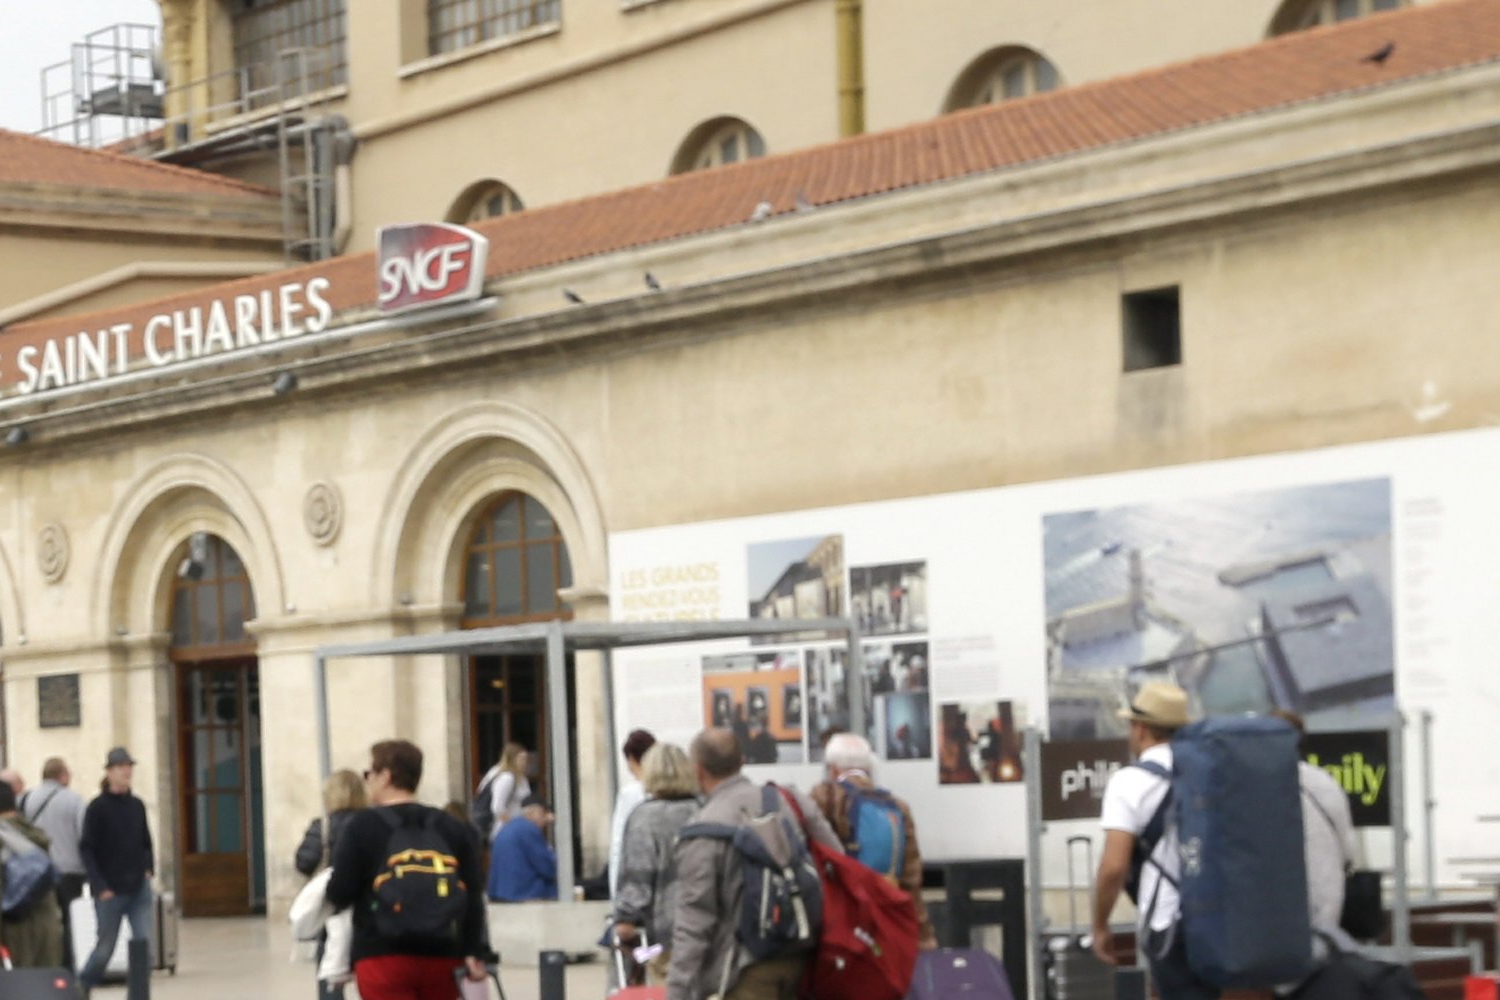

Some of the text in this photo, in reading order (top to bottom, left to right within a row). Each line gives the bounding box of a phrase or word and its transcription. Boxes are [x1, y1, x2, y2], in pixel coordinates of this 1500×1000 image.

[378, 241, 471, 303] SNCF
[17, 322, 133, 394] SAINT
[143, 276, 333, 366] CHARLES
[1061, 760, 1120, 801] phil
